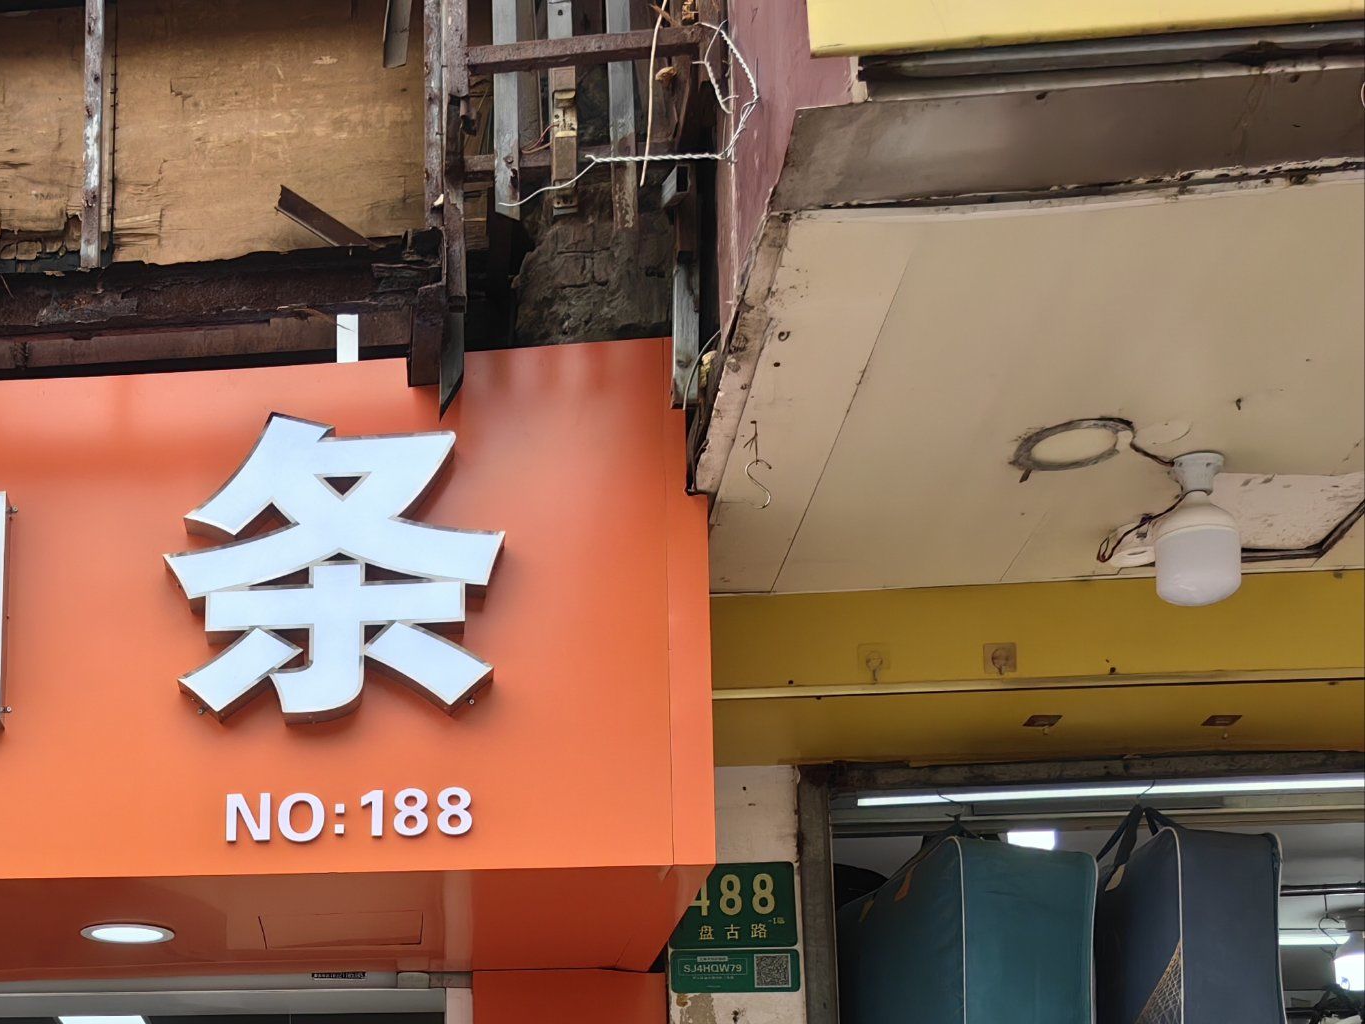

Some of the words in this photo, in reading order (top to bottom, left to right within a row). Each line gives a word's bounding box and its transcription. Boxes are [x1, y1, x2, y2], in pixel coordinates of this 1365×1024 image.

[224, 785, 476, 845] NO:188
[698, 923, 767, 940] 盘古路
[683, 963, 742, 973] SJ4HQW79
